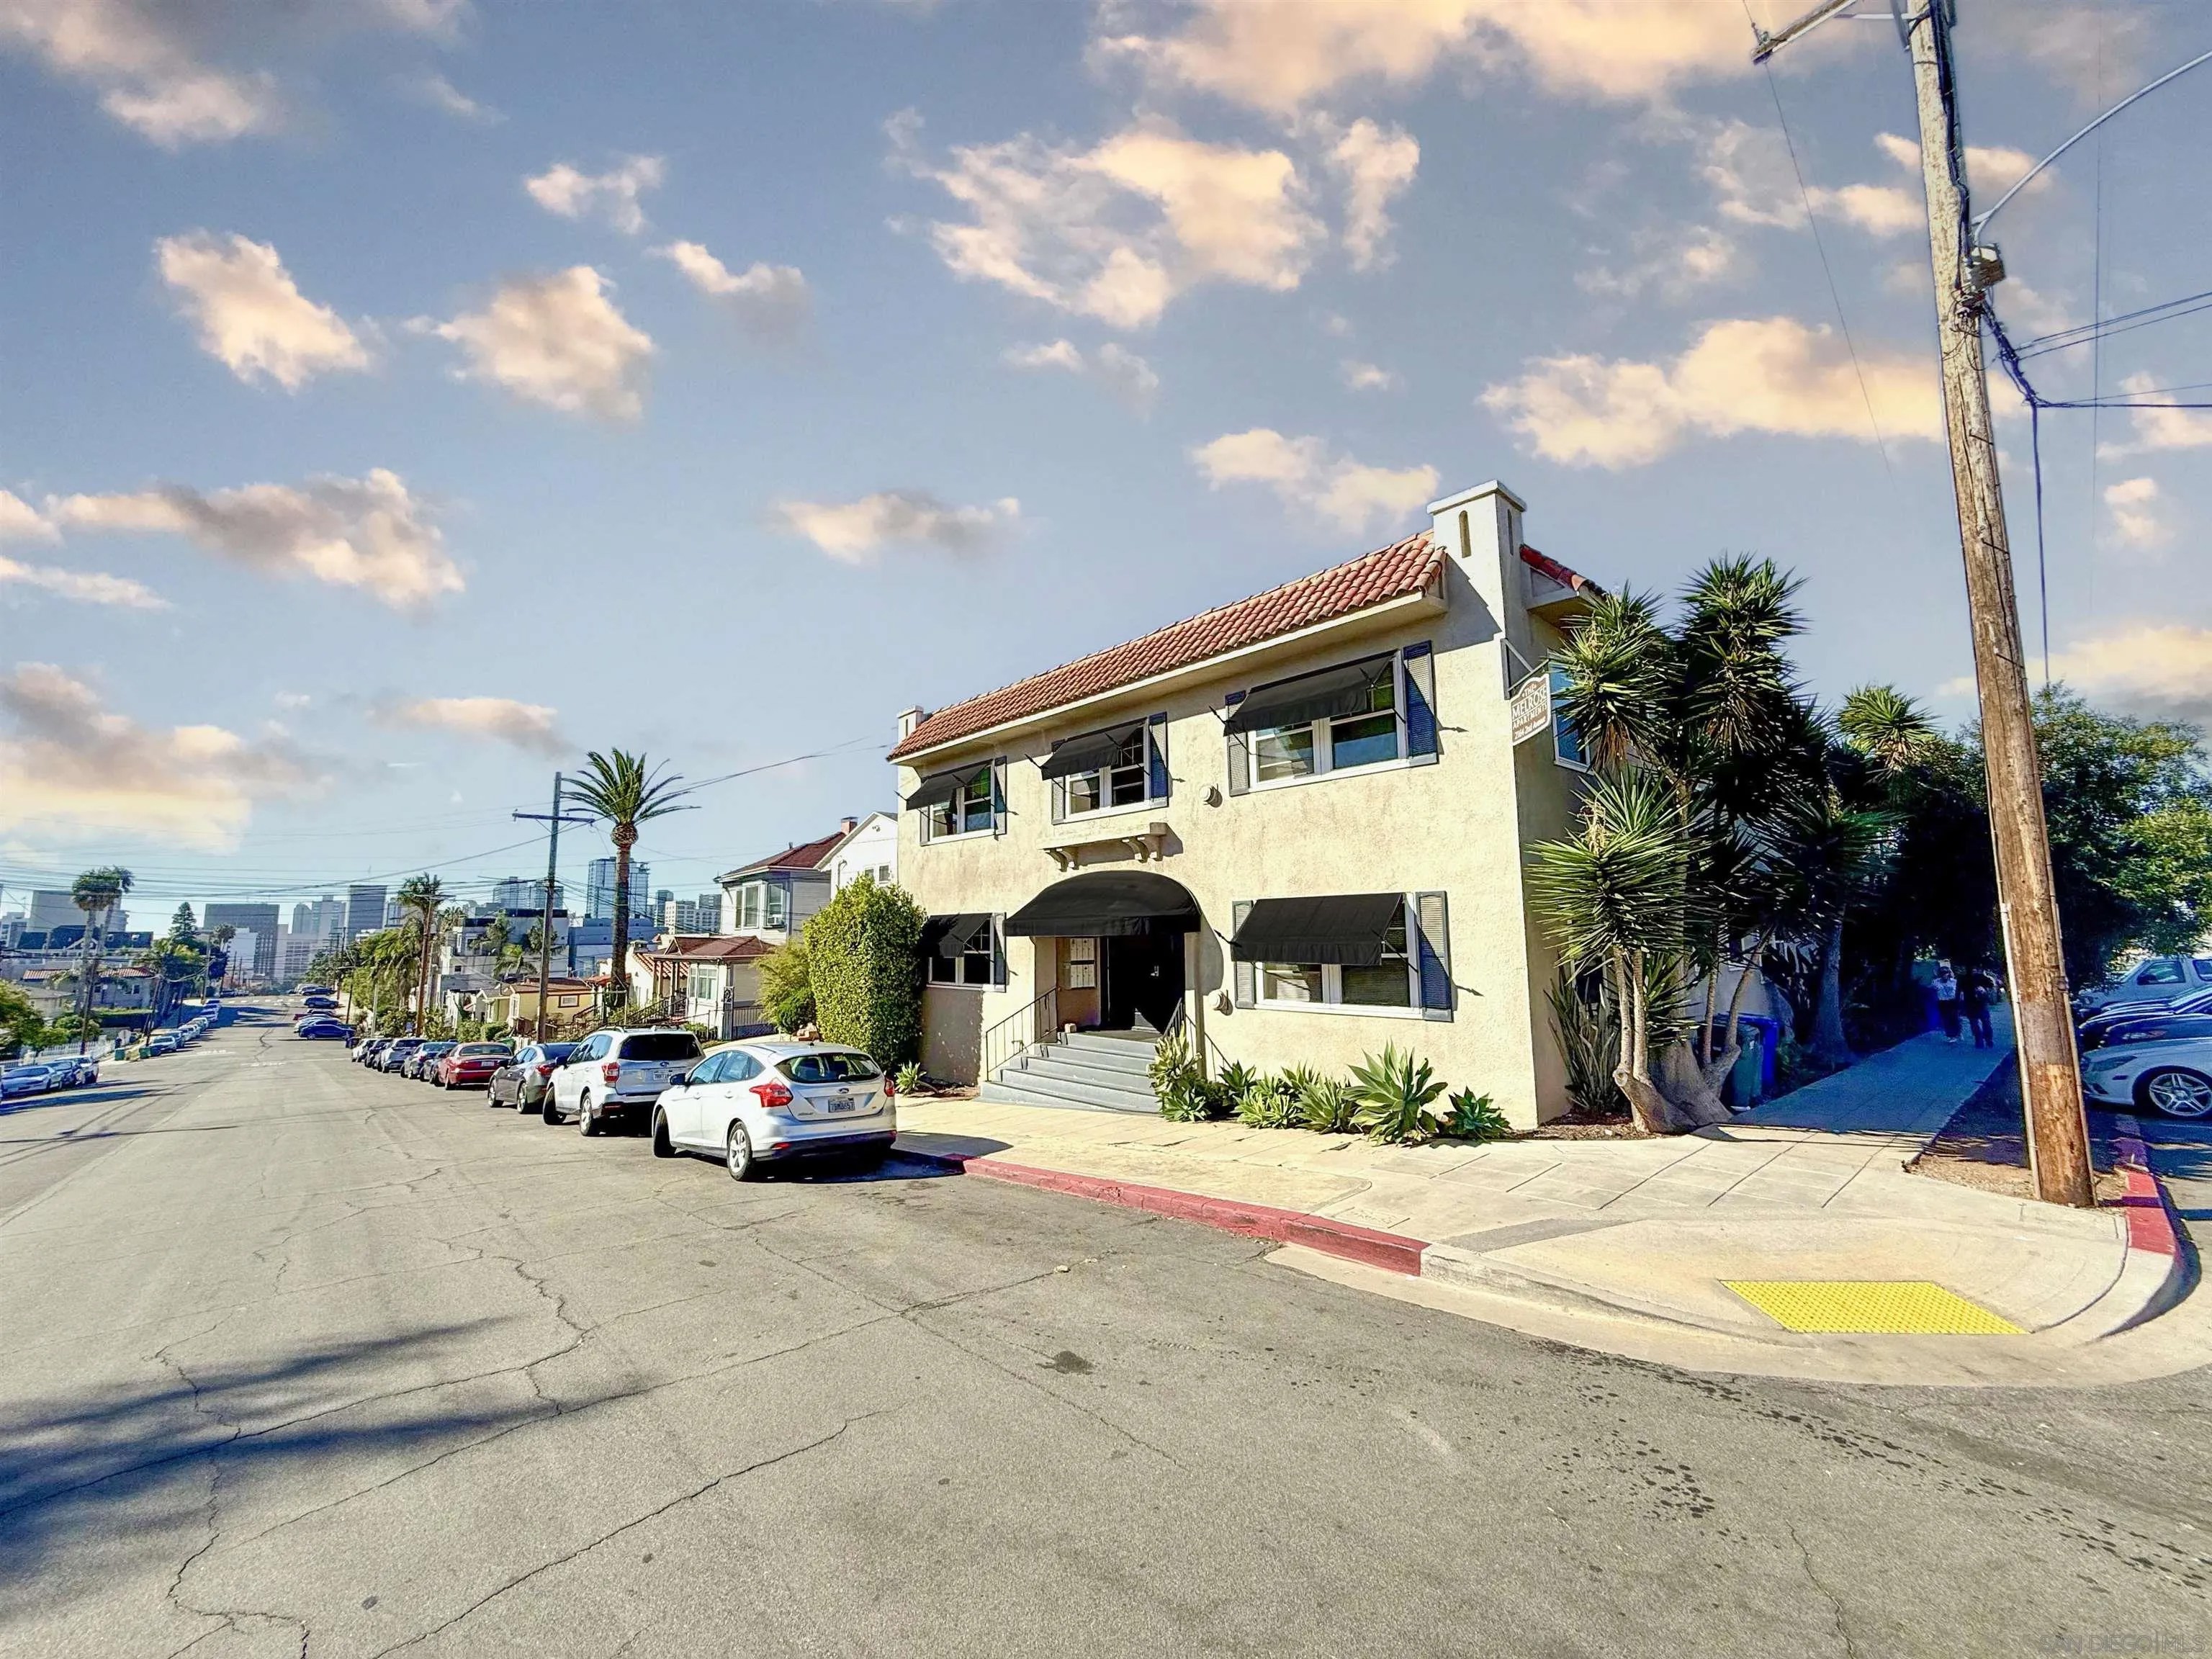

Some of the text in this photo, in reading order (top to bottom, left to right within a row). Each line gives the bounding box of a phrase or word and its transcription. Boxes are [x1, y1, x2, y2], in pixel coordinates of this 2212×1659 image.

[1512, 685, 1547, 721] MELROSE
[1524, 683, 1536, 696] THE
[1513, 702, 1547, 730] APARTMENTS
